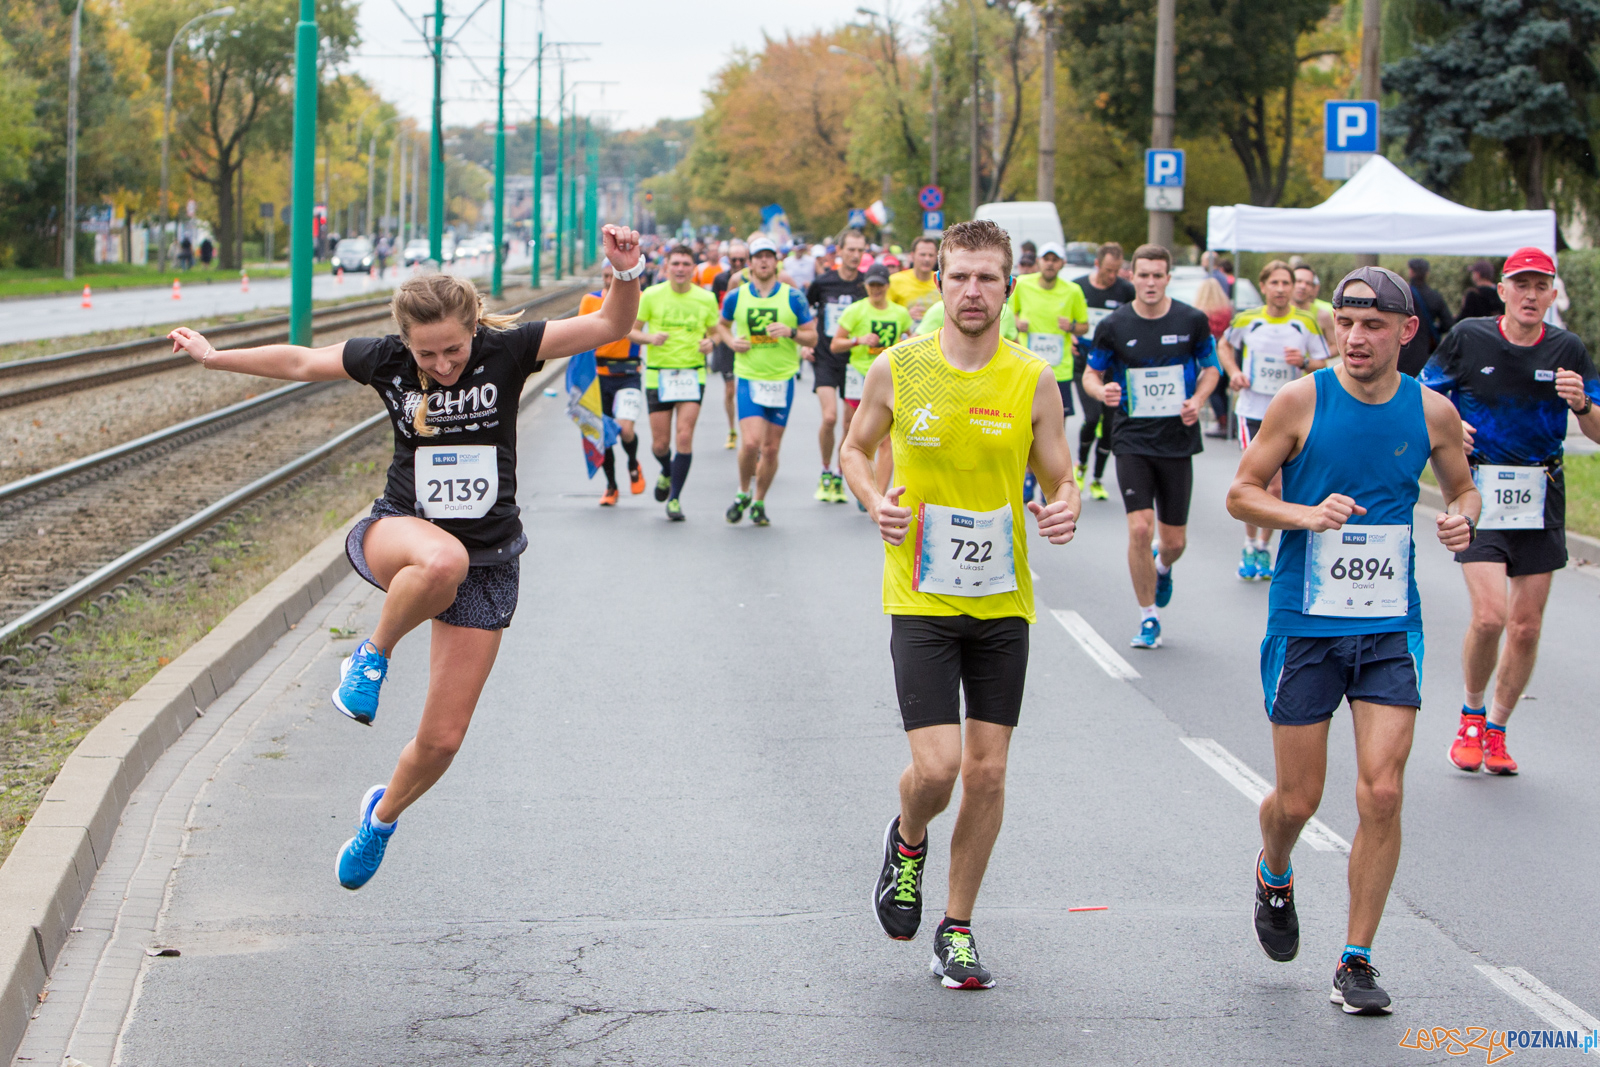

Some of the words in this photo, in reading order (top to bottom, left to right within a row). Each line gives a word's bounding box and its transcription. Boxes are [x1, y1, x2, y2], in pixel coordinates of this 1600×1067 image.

[1337, 106, 1368, 148] P
[1154, 153, 1177, 183] P
[927, 212, 941, 229] P
[1260, 367, 1288, 379] 5981
[1142, 383, 1176, 397] 1072
[969, 407, 1000, 417] HENMAR
[969, 418, 1012, 429] PACEMAKER
[981, 427, 1002, 436] TEAM
[427, 478, 490, 503] 2139
[1494, 489, 1532, 505] 1816
[960, 518, 973, 526] PKO
[950, 538, 993, 563] 722
[959, 563, 985, 571] Łukasz
[1330, 557, 1395, 581] 6894
